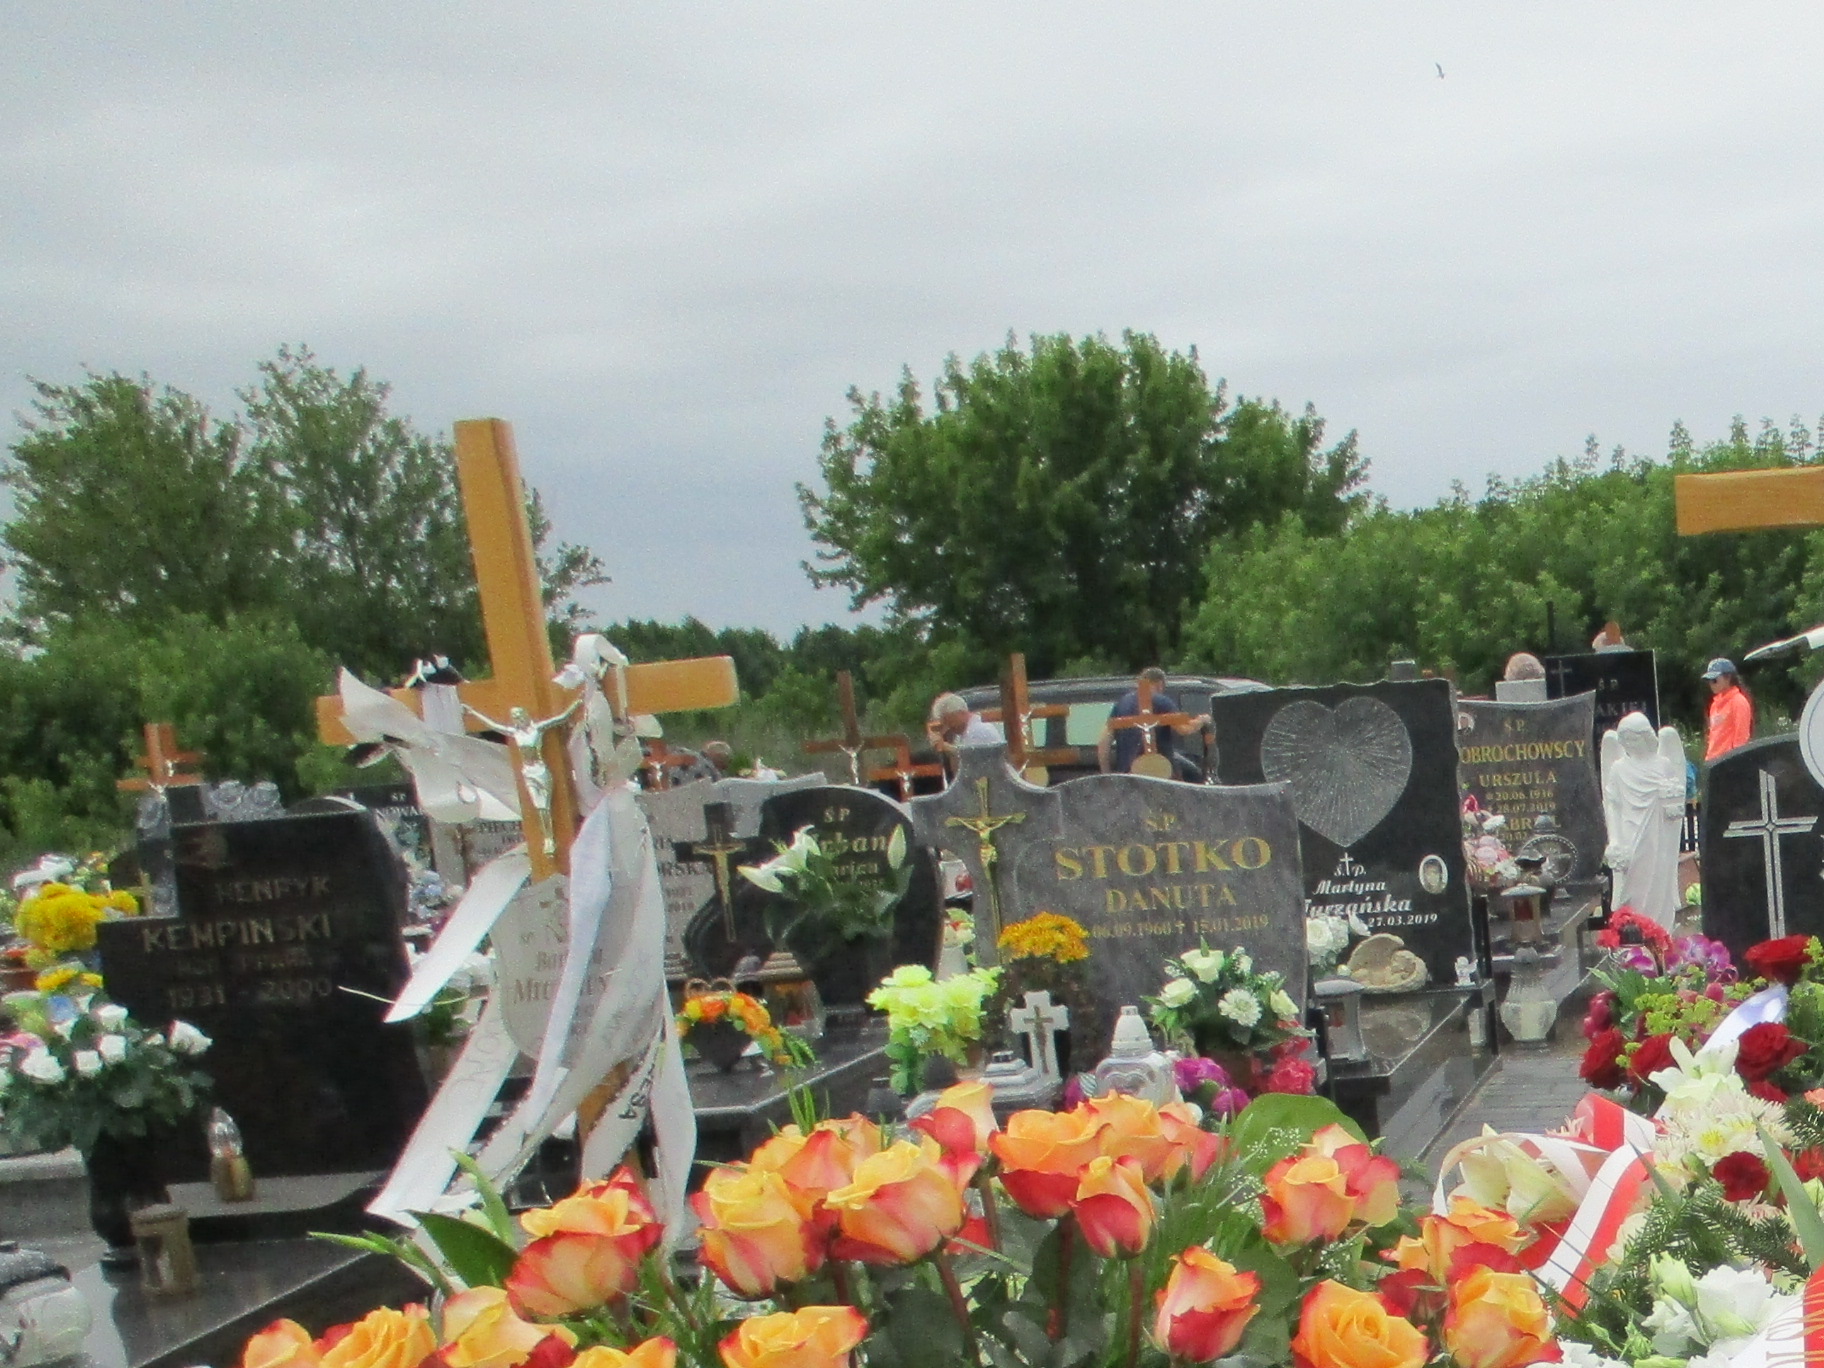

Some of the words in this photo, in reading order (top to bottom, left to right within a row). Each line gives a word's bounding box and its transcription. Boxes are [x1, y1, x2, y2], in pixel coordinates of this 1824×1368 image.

[1461, 740, 1586, 764] OBROCHOWSCY
[811, 832, 888, 854] rban
[1054, 836, 1272, 881] STOTKO
[1104, 883, 1238, 914] DANUTA
[1313, 880, 1387, 896] Martyna
[1367, 913, 1438, 928] 27.03.2019
